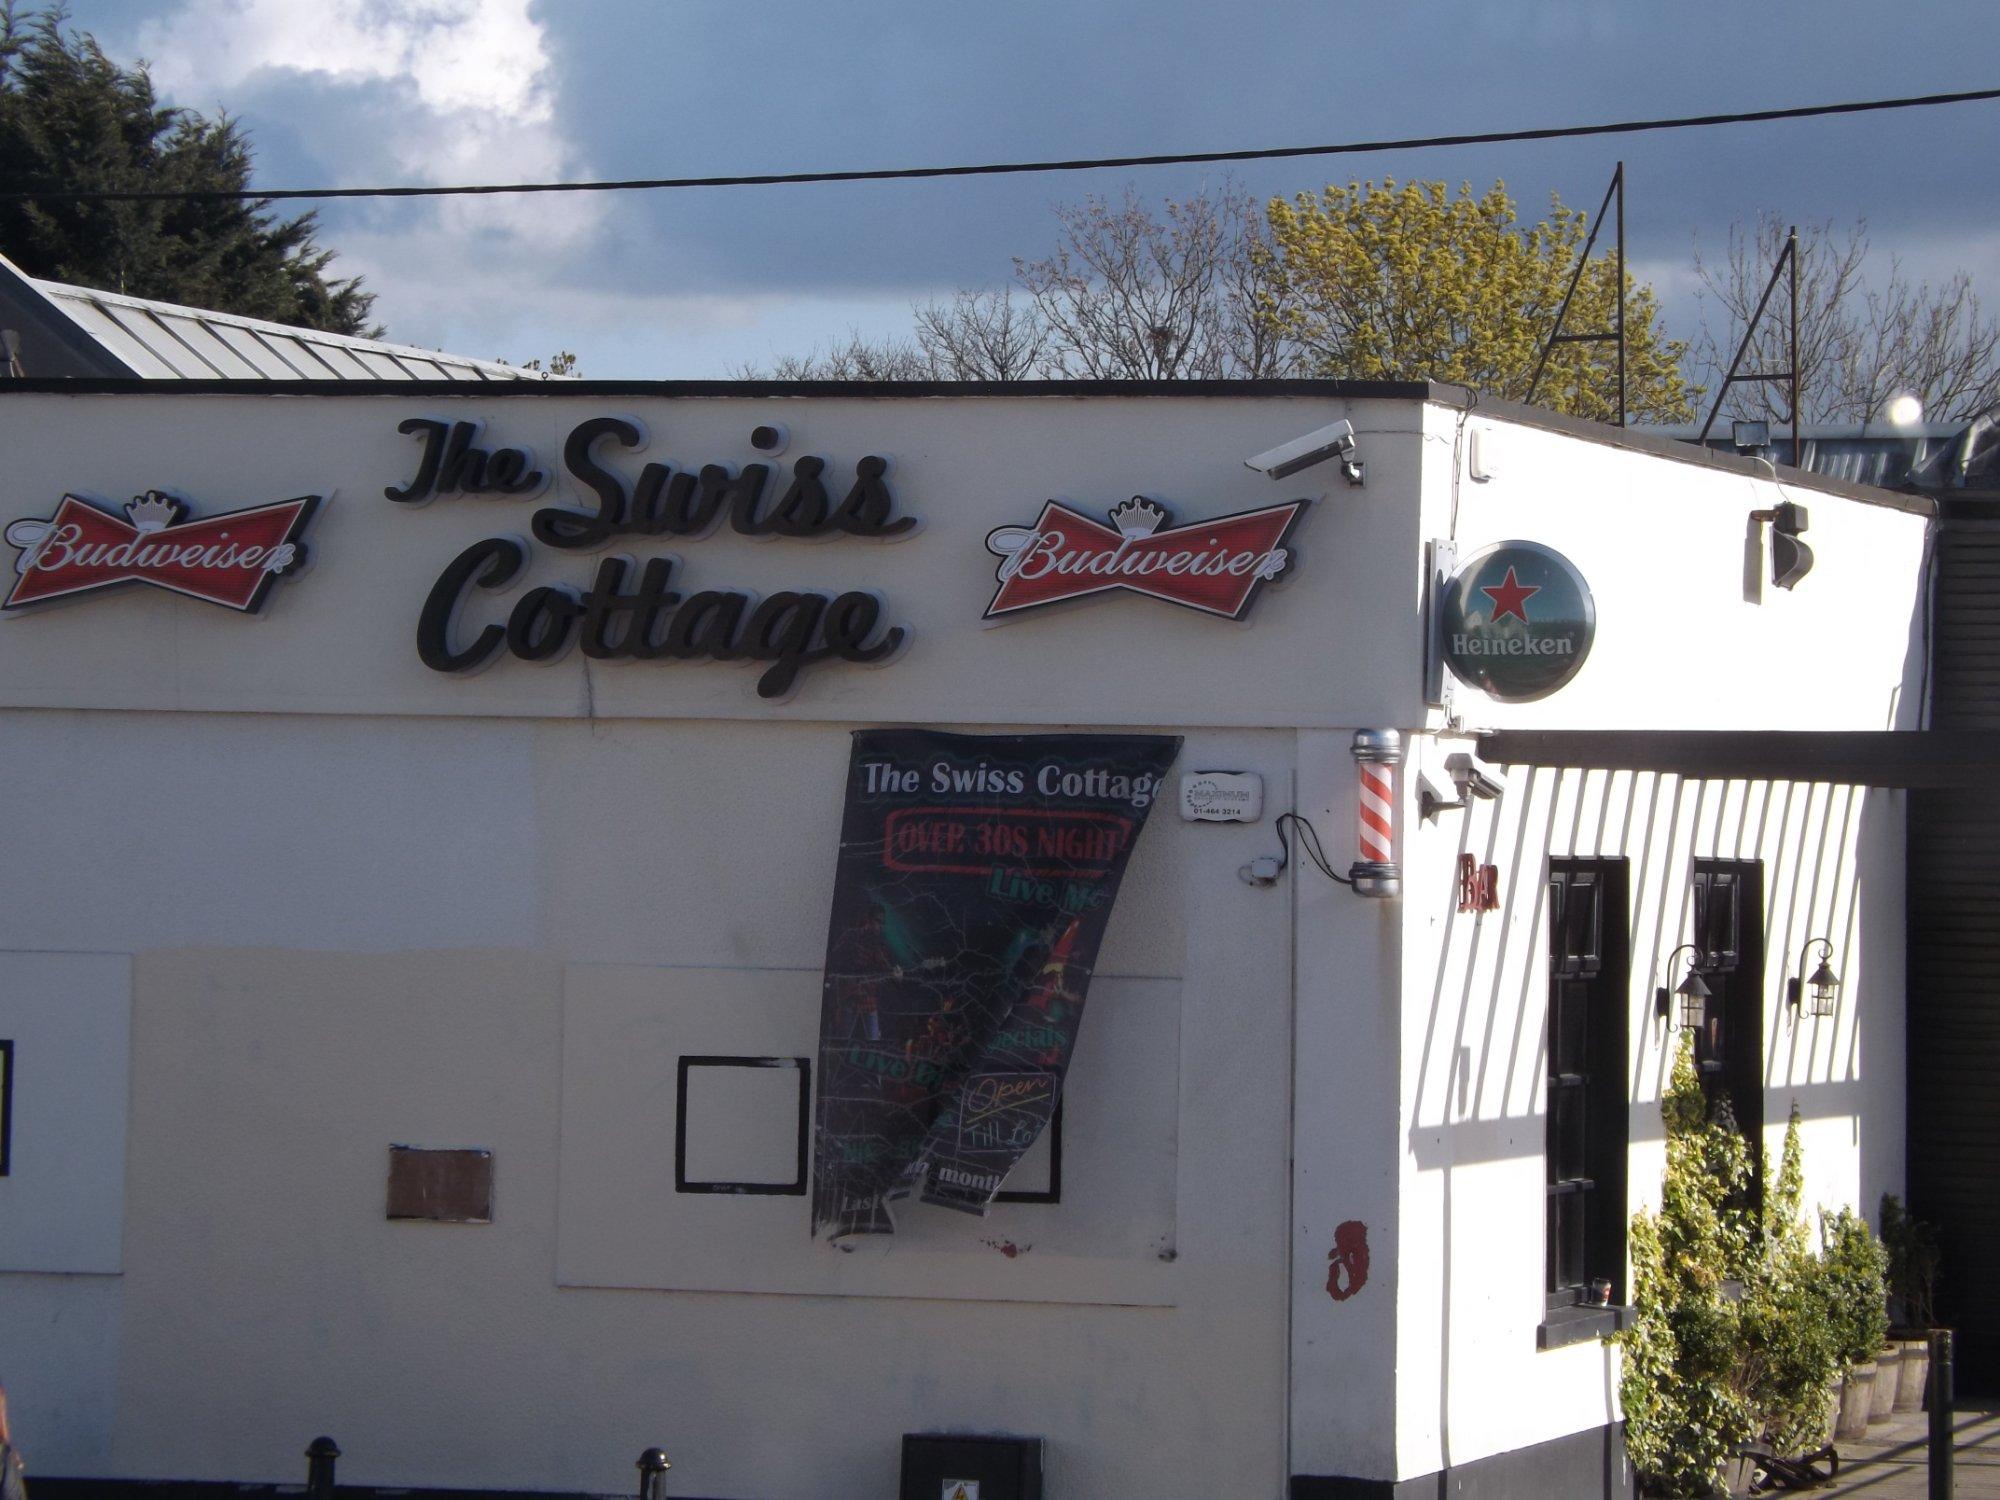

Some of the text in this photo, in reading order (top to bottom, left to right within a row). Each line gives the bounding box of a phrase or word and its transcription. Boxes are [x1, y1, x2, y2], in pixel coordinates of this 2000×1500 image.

[386, 418, 918, 548] The Swiss
[5, 520, 296, 574] Budweiser
[986, 528, 1288, 580] Budweiser
[416, 538, 904, 699] Cottage
[1452, 633, 1574, 655] Heineken
[864, 762, 920, 793] The
[931, 762, 1024, 794] Swiss
[897, 821, 966, 854] OVER
[1037, 826, 1119, 861] NIGHT
[989, 867, 1055, 905] Live
[967, 1078, 1049, 1113] Open
